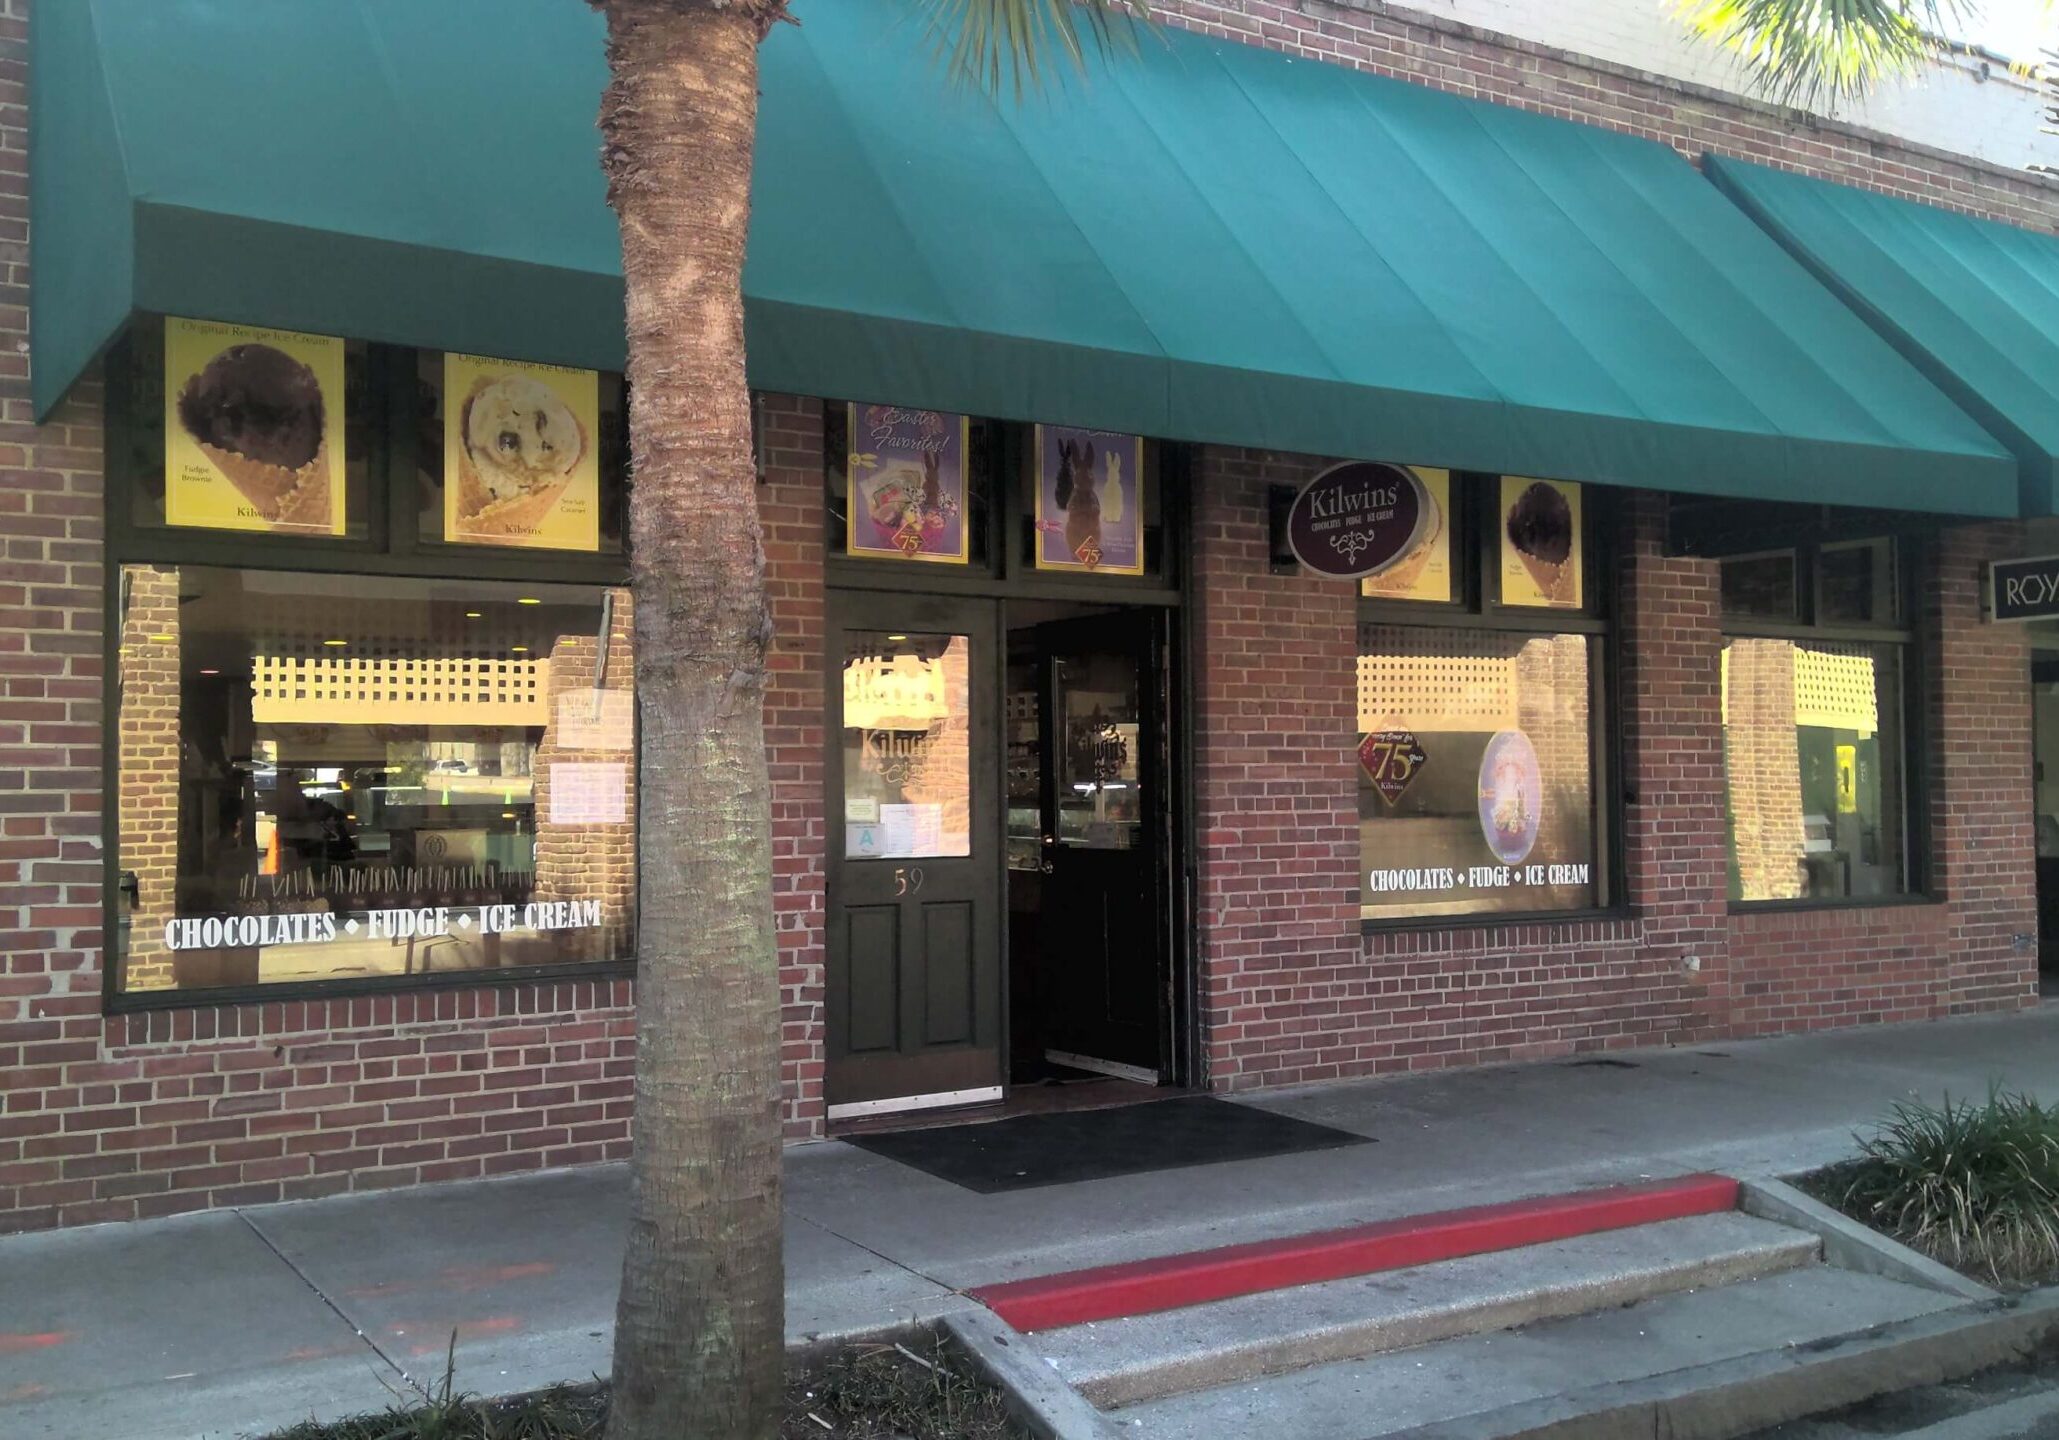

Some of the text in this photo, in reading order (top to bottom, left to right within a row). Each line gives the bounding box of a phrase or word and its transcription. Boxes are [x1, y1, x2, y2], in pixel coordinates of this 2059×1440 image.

[870, 425, 950, 452] Favorites!
[1308, 482, 1398, 519] Kilwins
[1312, 519, 1341, 532] CHOCOLATES
[900, 535, 919, 551] 75
[1083, 549, 1099, 563] 75
[2007, 572, 2059, 606] ROY
[1372, 743, 1412, 780] 75
[894, 867, 924, 897] 59
[1370, 864, 1589, 892] CHOCOLATES FUDGE ICE CREAM
[165, 899, 602, 950] CHOCOLATES FUDGE ICE CREAM
